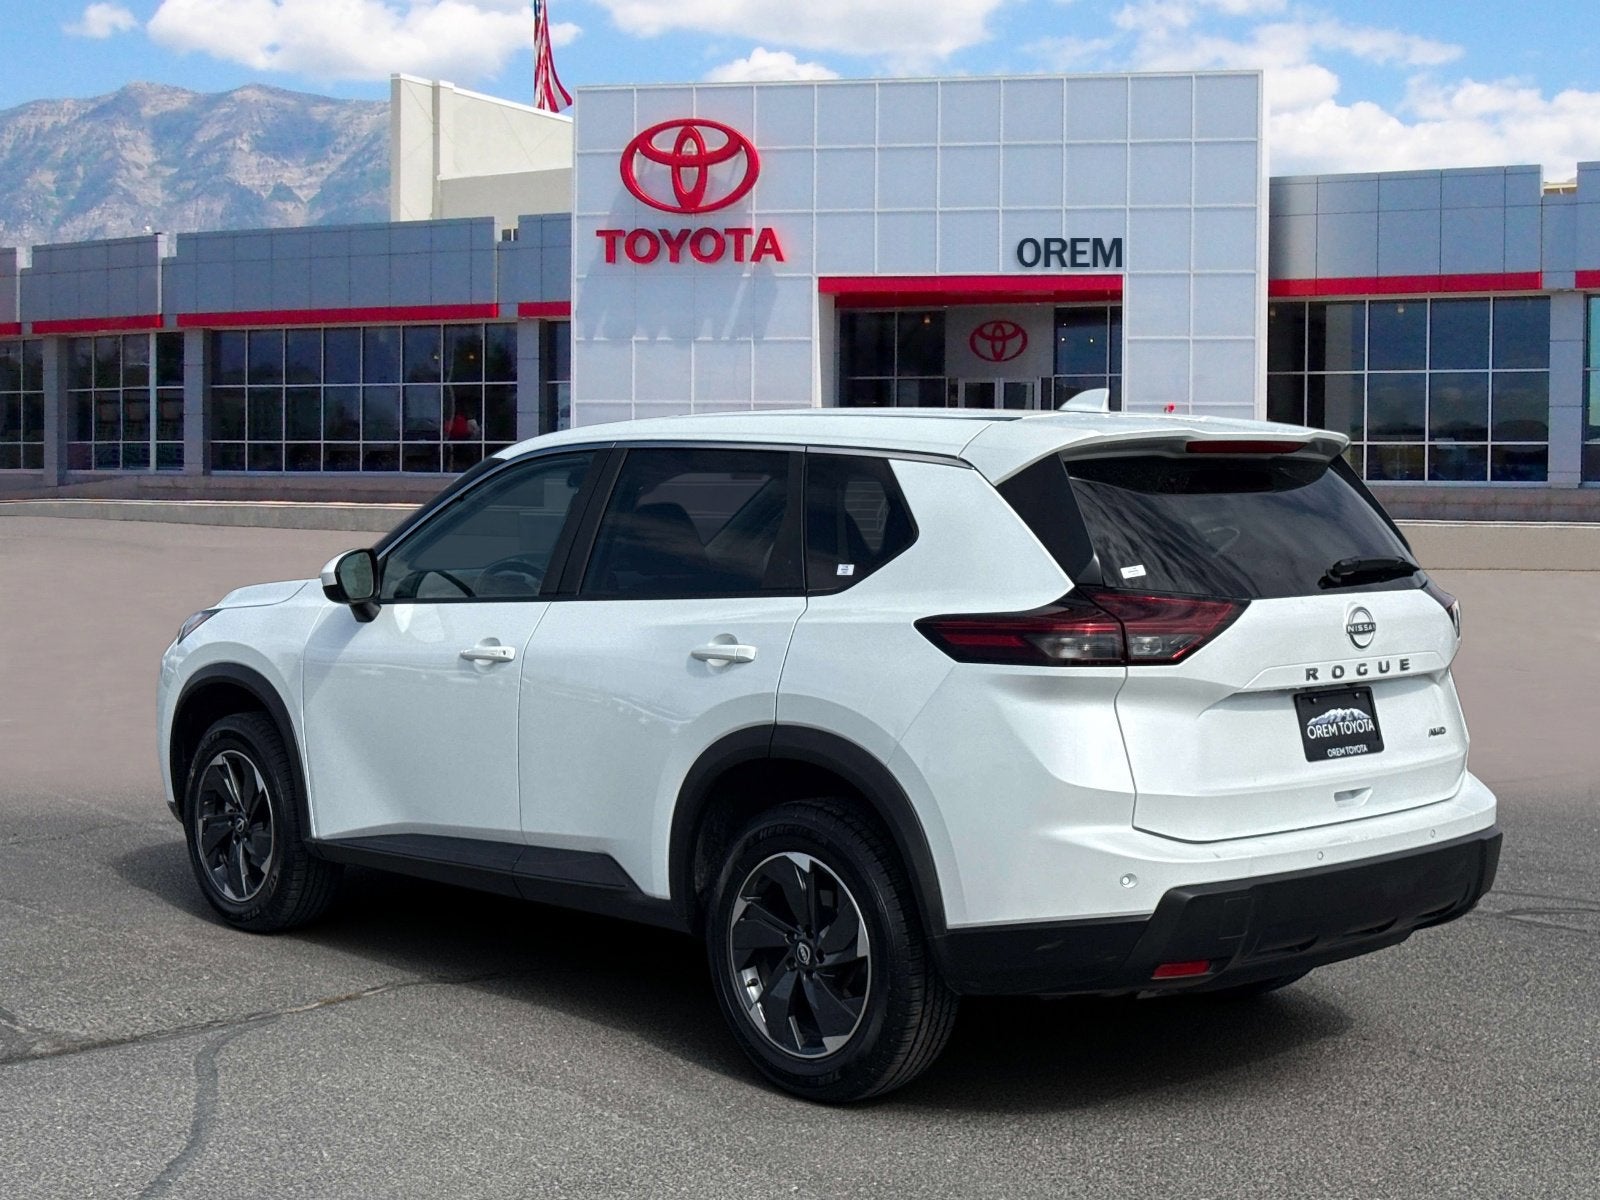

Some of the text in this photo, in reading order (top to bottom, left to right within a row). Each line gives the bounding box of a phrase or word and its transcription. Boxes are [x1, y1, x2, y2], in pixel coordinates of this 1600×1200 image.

[596, 227, 785, 264] TOYOTA
[1017, 237, 1123, 268] OREM
[1305, 658, 1411, 681] ROGUE
[1307, 718, 1376, 739] OREM TOYOTA
[1327, 744, 1368, 757] OREM TOYOTA
